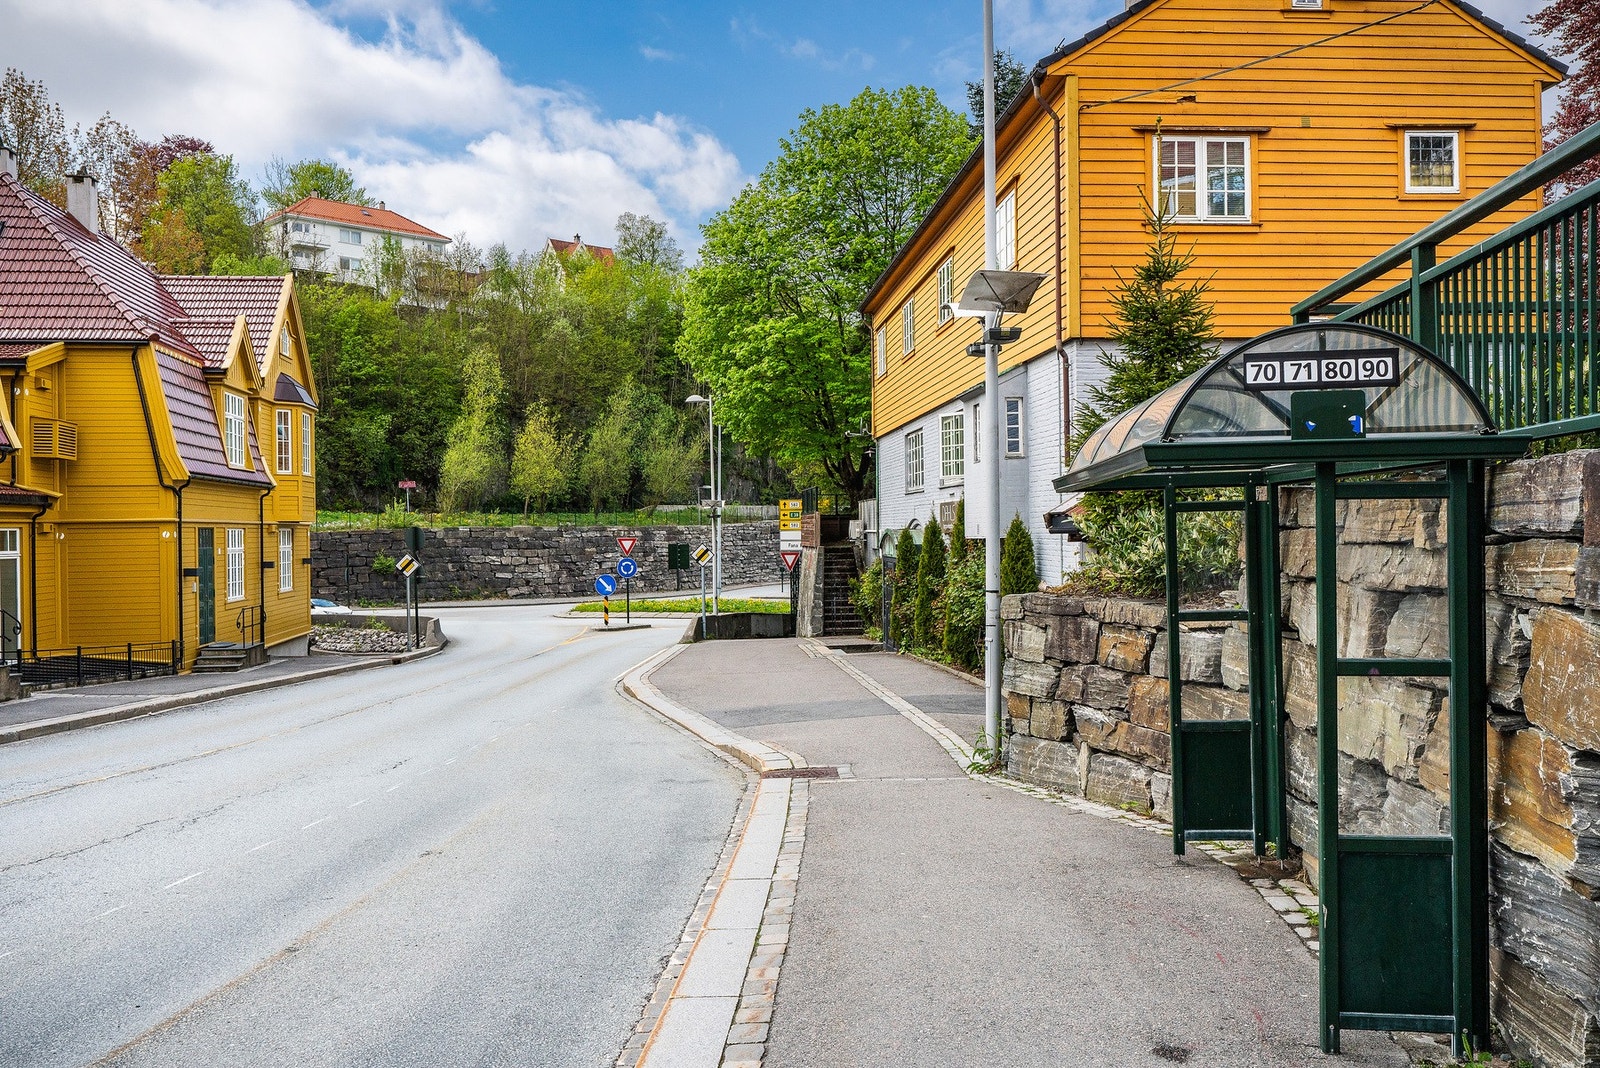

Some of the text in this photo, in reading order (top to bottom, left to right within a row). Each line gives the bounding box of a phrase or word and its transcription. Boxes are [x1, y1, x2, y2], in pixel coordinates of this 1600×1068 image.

[1250, 359, 1390, 382] 70 71 80 90
